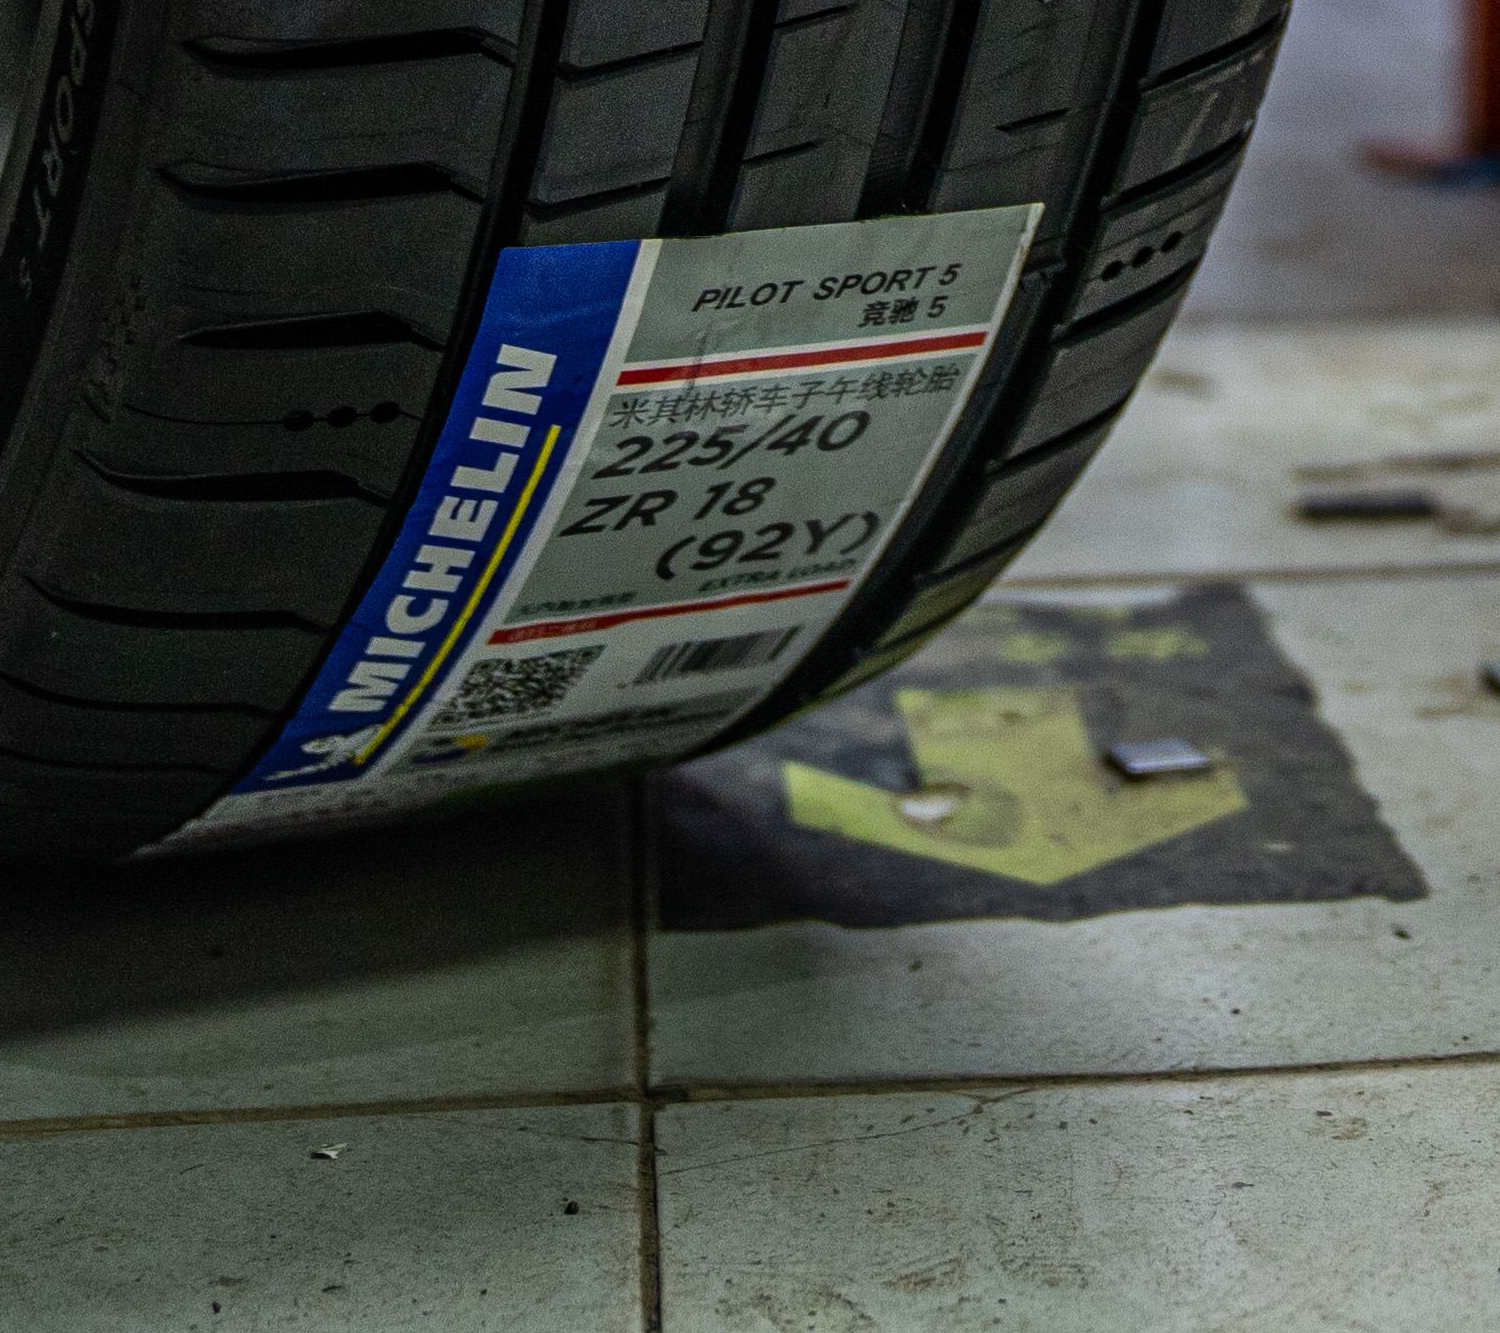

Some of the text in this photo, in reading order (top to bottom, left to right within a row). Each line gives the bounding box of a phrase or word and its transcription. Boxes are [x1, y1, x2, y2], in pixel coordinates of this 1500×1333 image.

[691, 263, 962, 314] PILOT SPORT 5
[856, 296, 949, 329] 竞驰 5
[608, 365, 961, 431] 米其林轿车子午线轮胎
[591, 410, 872, 480] 225/40
[328, 342, 558, 715] MICHELIN
[558, 477, 777, 537] ZR 18
[654, 509, 883, 582] (92Y)
